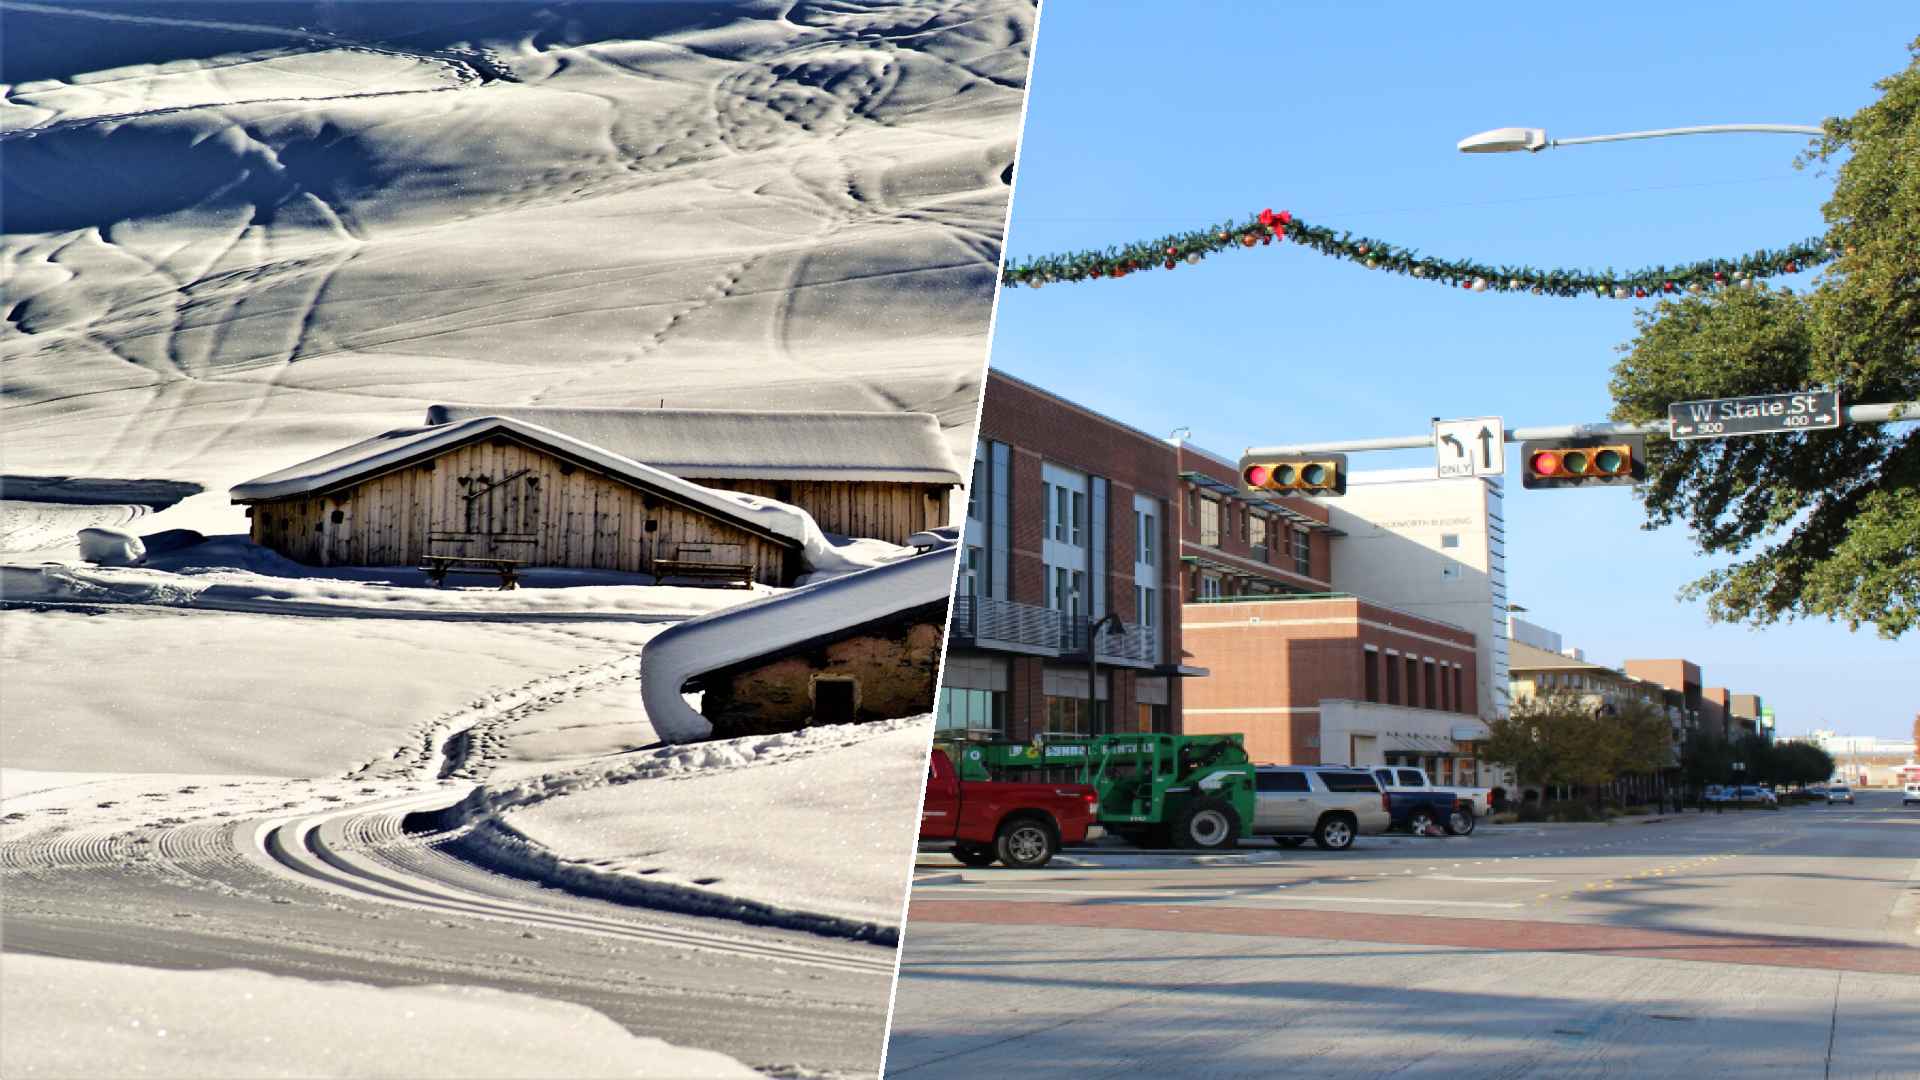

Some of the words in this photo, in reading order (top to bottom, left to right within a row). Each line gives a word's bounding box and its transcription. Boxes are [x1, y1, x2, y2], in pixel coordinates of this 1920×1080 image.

[1690, 403, 1713, 422] W
[1721, 399, 1784, 420] State
[1791, 395, 1817, 414] St
[1783, 415, 1809, 427] 400
[1697, 422, 1724, 434] 500
[1440, 463, 1472, 475] ONLY
